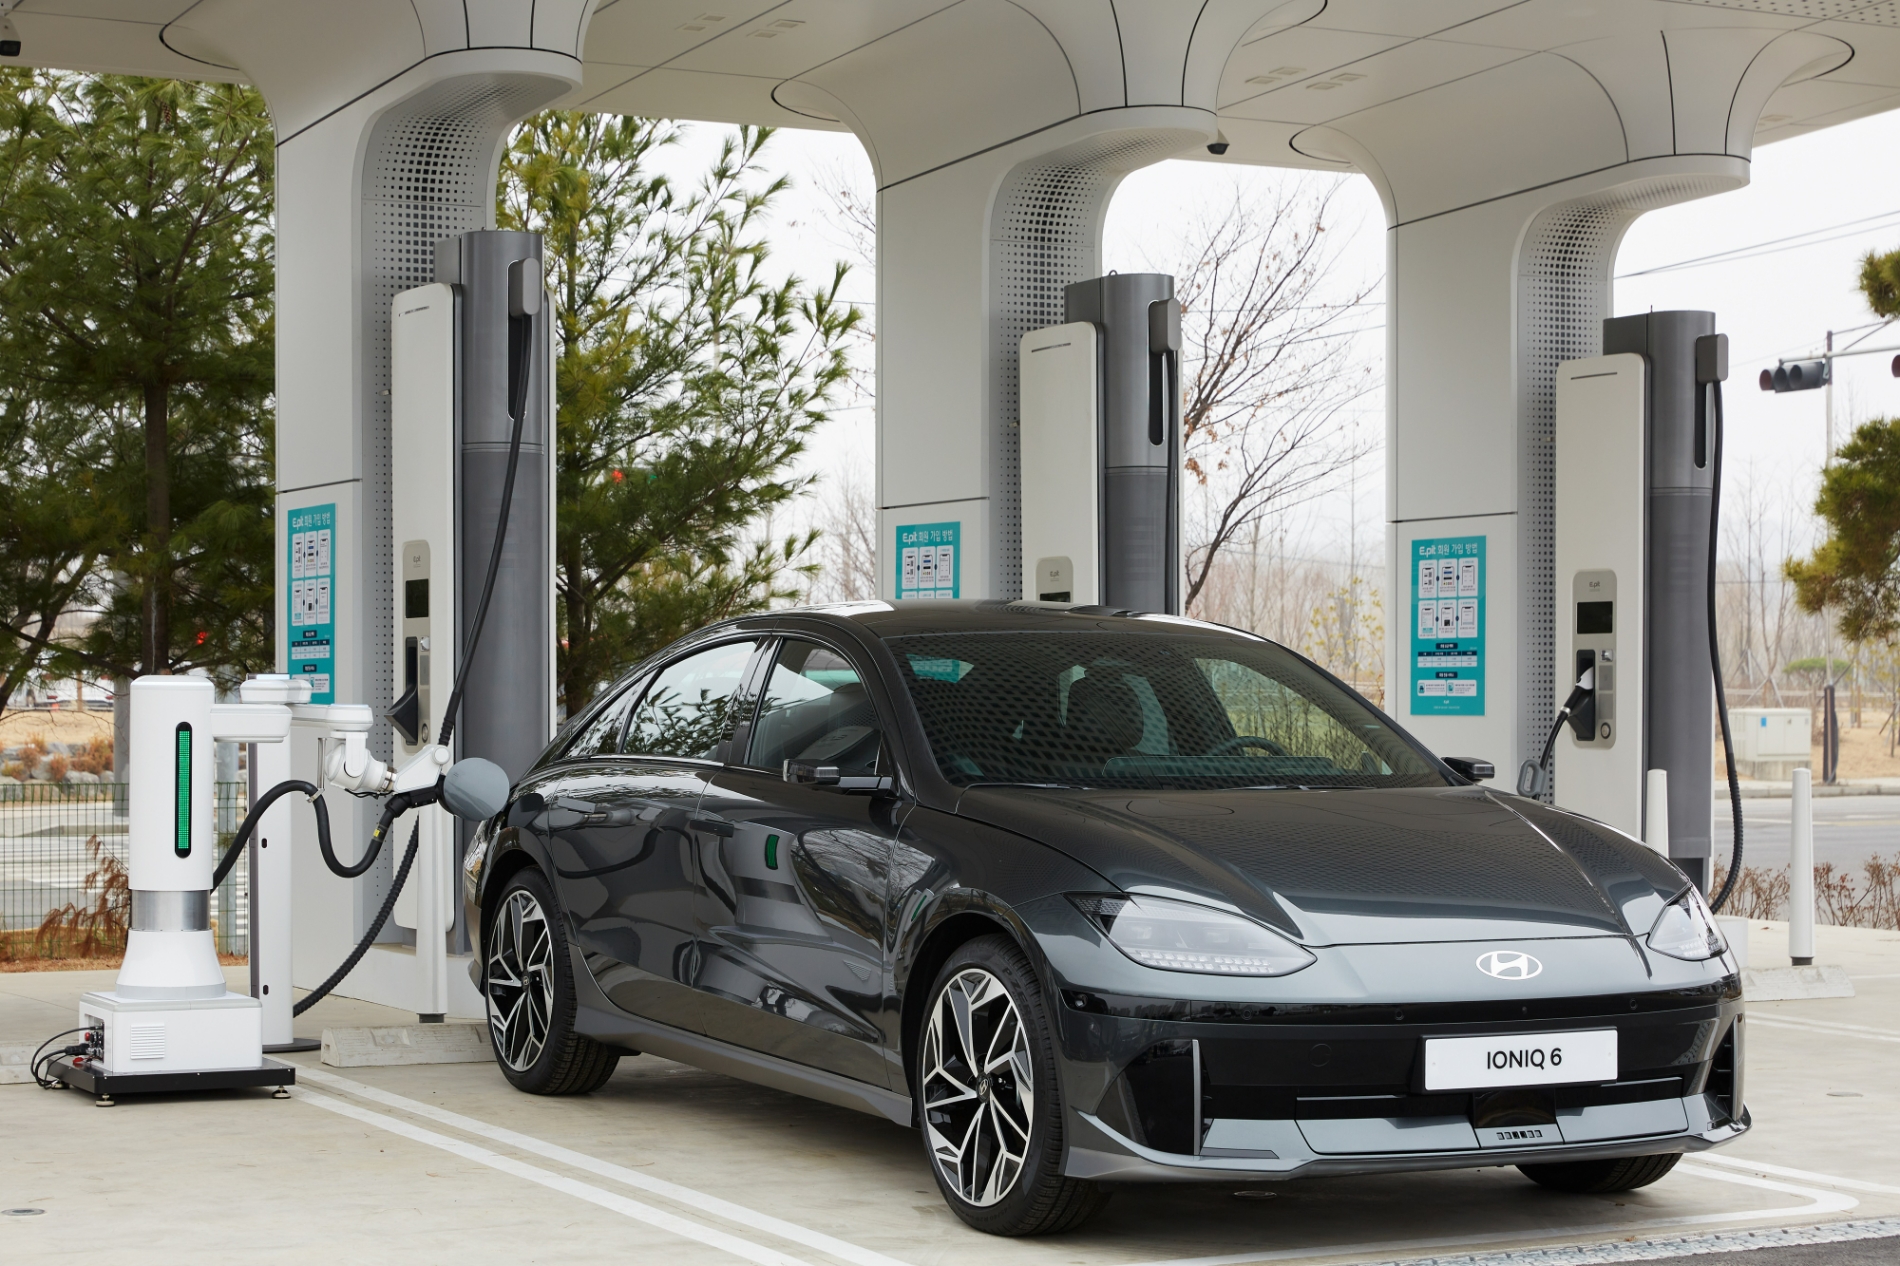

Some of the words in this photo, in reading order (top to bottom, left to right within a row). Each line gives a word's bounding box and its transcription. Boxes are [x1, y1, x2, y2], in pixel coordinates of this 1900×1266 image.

[1437, 544, 1449, 556] 회원
[1451, 543, 1463, 554] 가입
[1465, 542, 1478, 554] 방법
[1487, 1048, 1545, 1070] IONIQ
[1550, 1047, 1562, 1066] 6
